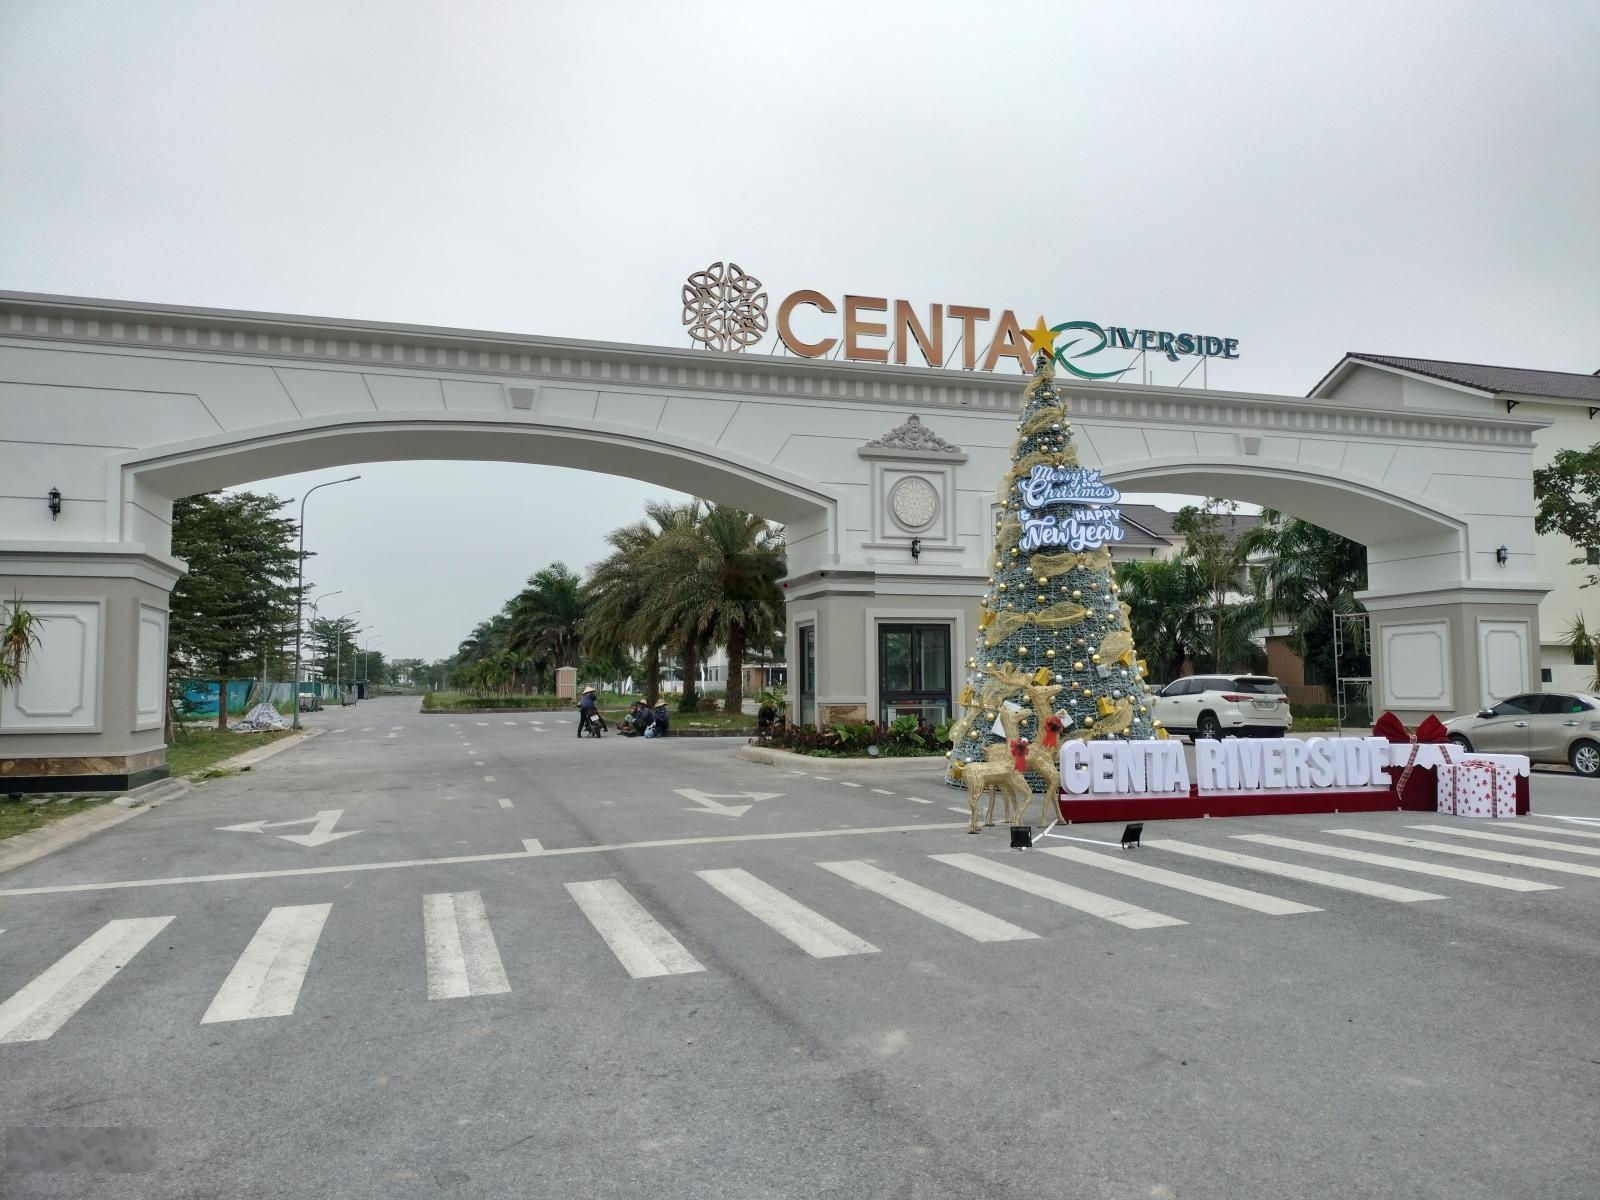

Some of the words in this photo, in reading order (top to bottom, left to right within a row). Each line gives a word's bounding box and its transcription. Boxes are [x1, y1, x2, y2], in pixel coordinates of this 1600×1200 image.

[776, 289, 1036, 374] CENTA
[1049, 320, 1240, 379] RIVERSIDE
[1031, 464, 1082, 487] Merry
[1019, 479, 1120, 508] Christmas
[1074, 509, 1121, 521] HAPPY
[1019, 516, 1070, 550] New
[1061, 518, 1125, 551] Year
[1060, 740, 1190, 794] CENTA
[1195, 737, 1391, 790] RIVERSIDE
